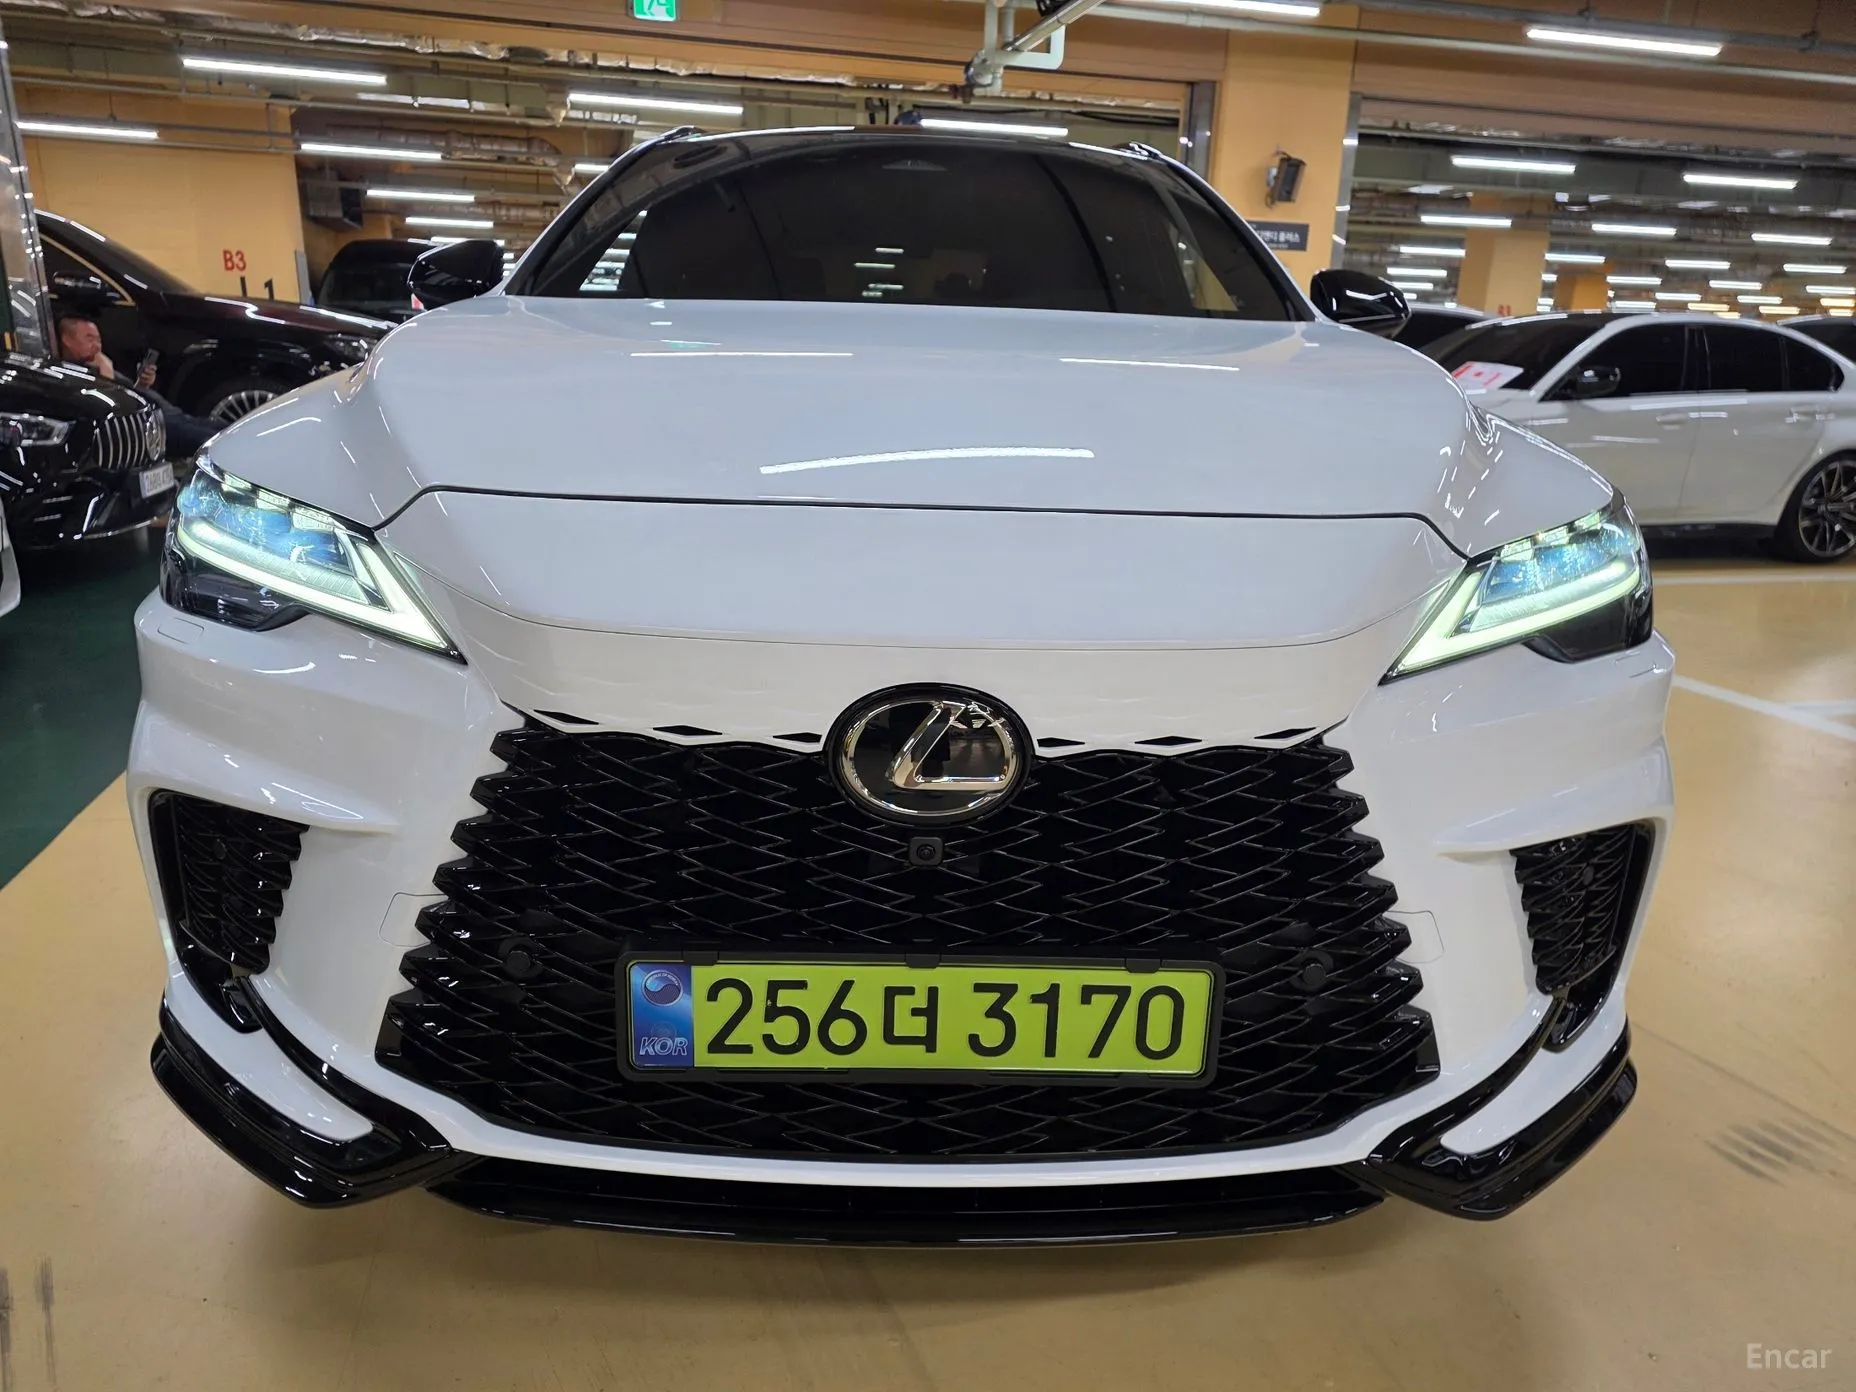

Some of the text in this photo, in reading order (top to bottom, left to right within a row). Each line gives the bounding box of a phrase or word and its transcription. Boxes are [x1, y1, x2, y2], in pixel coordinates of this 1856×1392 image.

[223, 249, 247, 271] B3
[706, 977, 1185, 1060] 256더 3170
[639, 1037, 688, 1055] KOR
